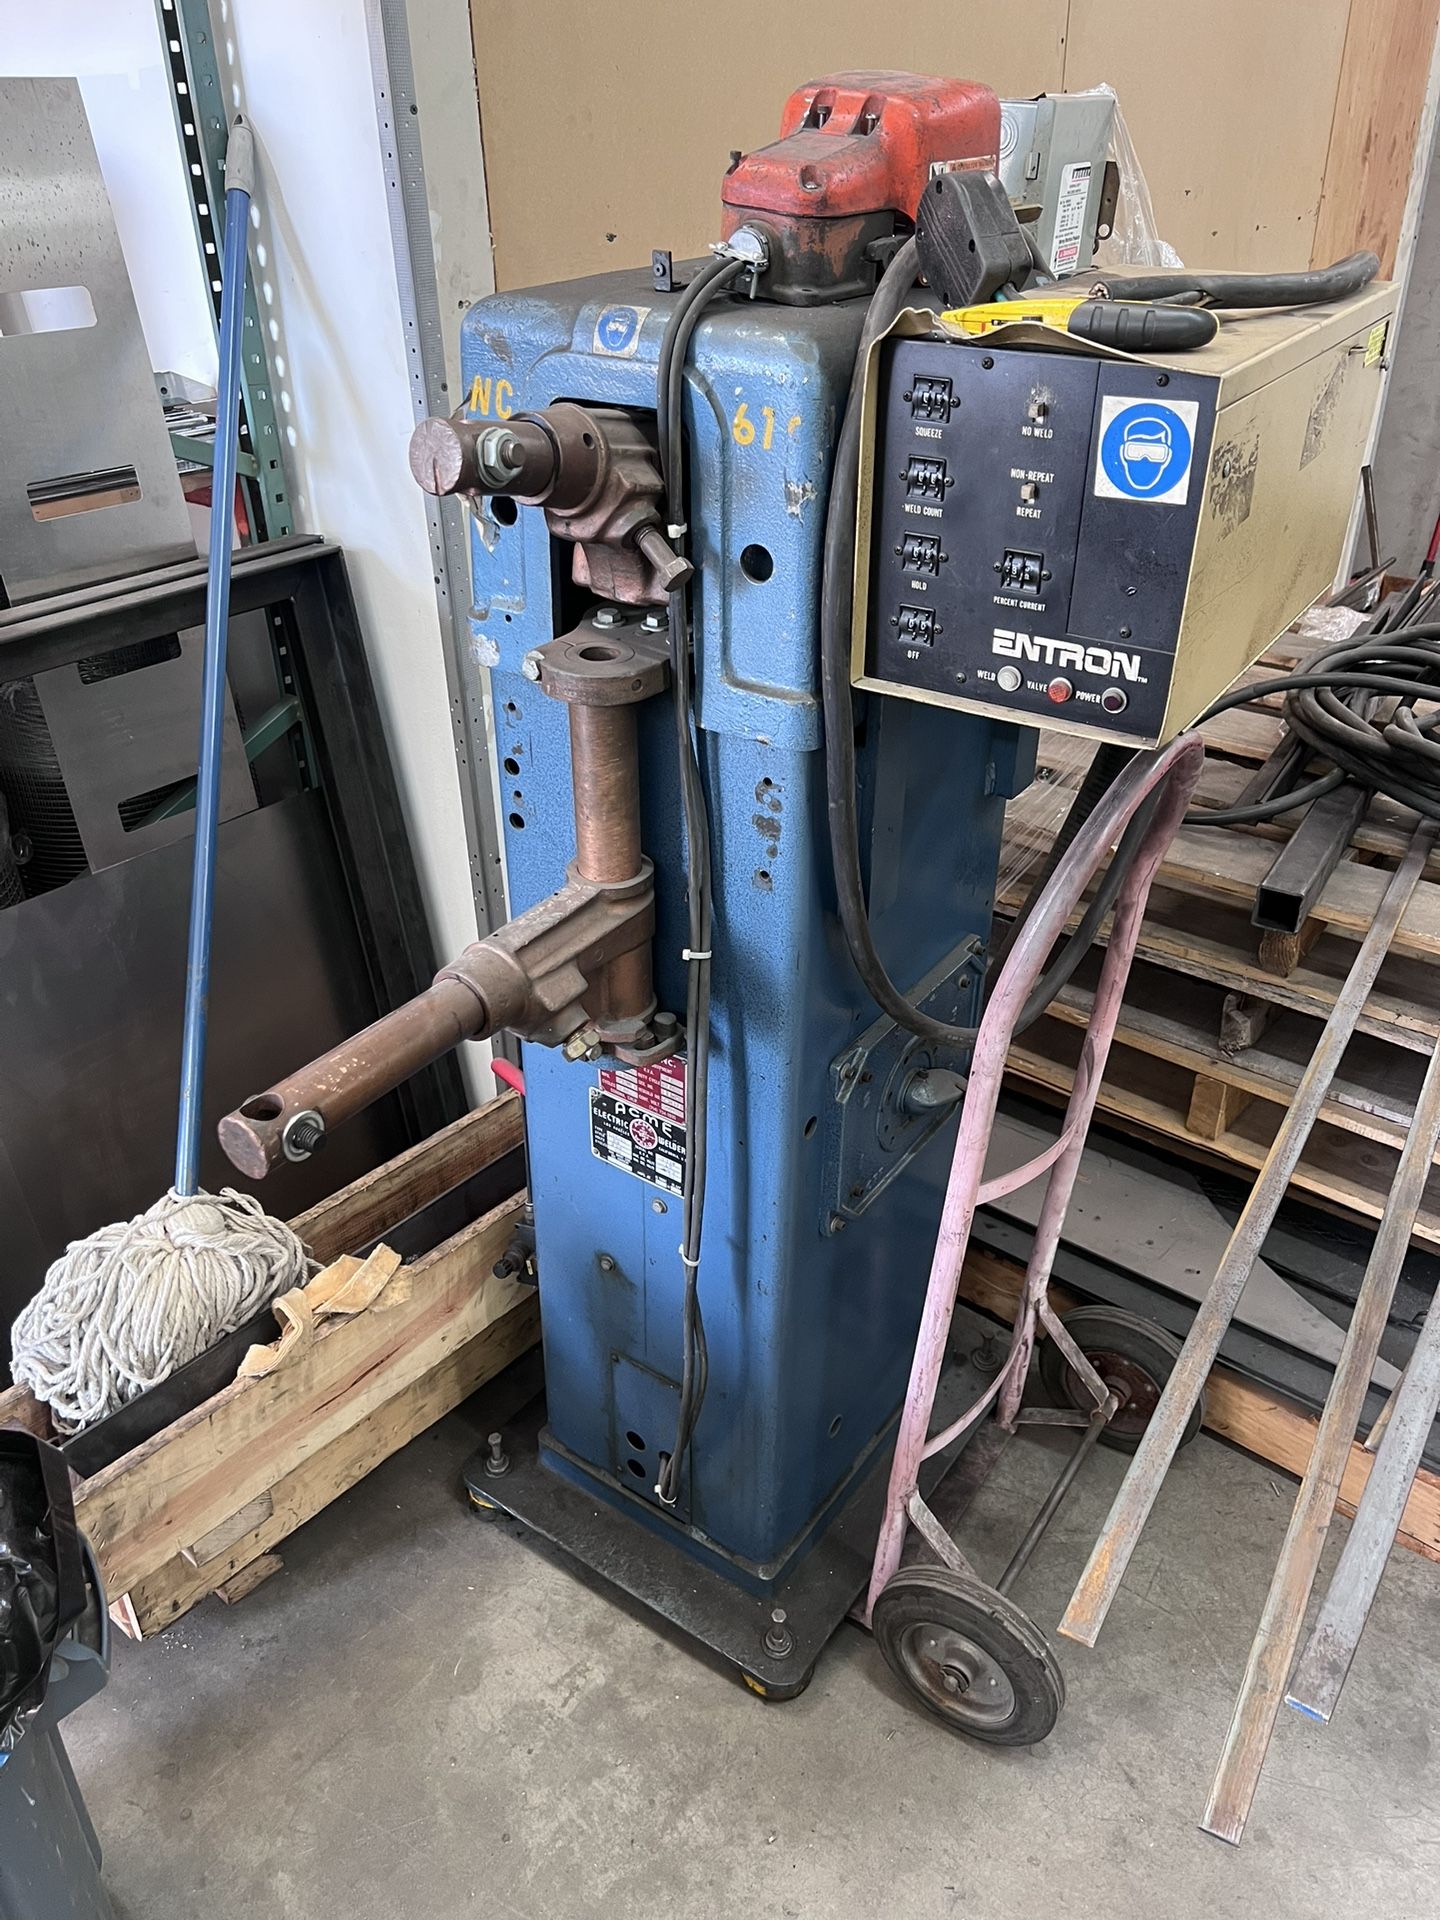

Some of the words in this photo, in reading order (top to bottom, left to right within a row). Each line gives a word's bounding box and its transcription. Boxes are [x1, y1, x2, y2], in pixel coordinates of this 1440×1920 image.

[469, 375, 513, 418] NC
[915, 426, 943, 439] SQUEEZE
[1022, 425, 1032, 437] NO
[1034, 427, 1053, 439] WELD
[1011, 468, 1055, 483] NON-REPEAT
[905, 504, 922, 515] WELD
[923, 506, 943, 518] COUNT
[1016, 506, 1041, 519] REPEAT
[911, 580, 928, 591] HOLD
[993, 595, 1019, 608] PERCENT
[1019, 600, 1046, 612] CURRENT
[907, 650, 920, 660] OFF
[992, 628, 1141, 682] ENTRON
[977, 669, 996, 682] WELD
[1027, 680, 1048, 693] VALVE
[1075, 690, 1102, 704] POWER
[593, 1107, 630, 1130] ELECTRIC
[615, 1101, 673, 1139] ACME
